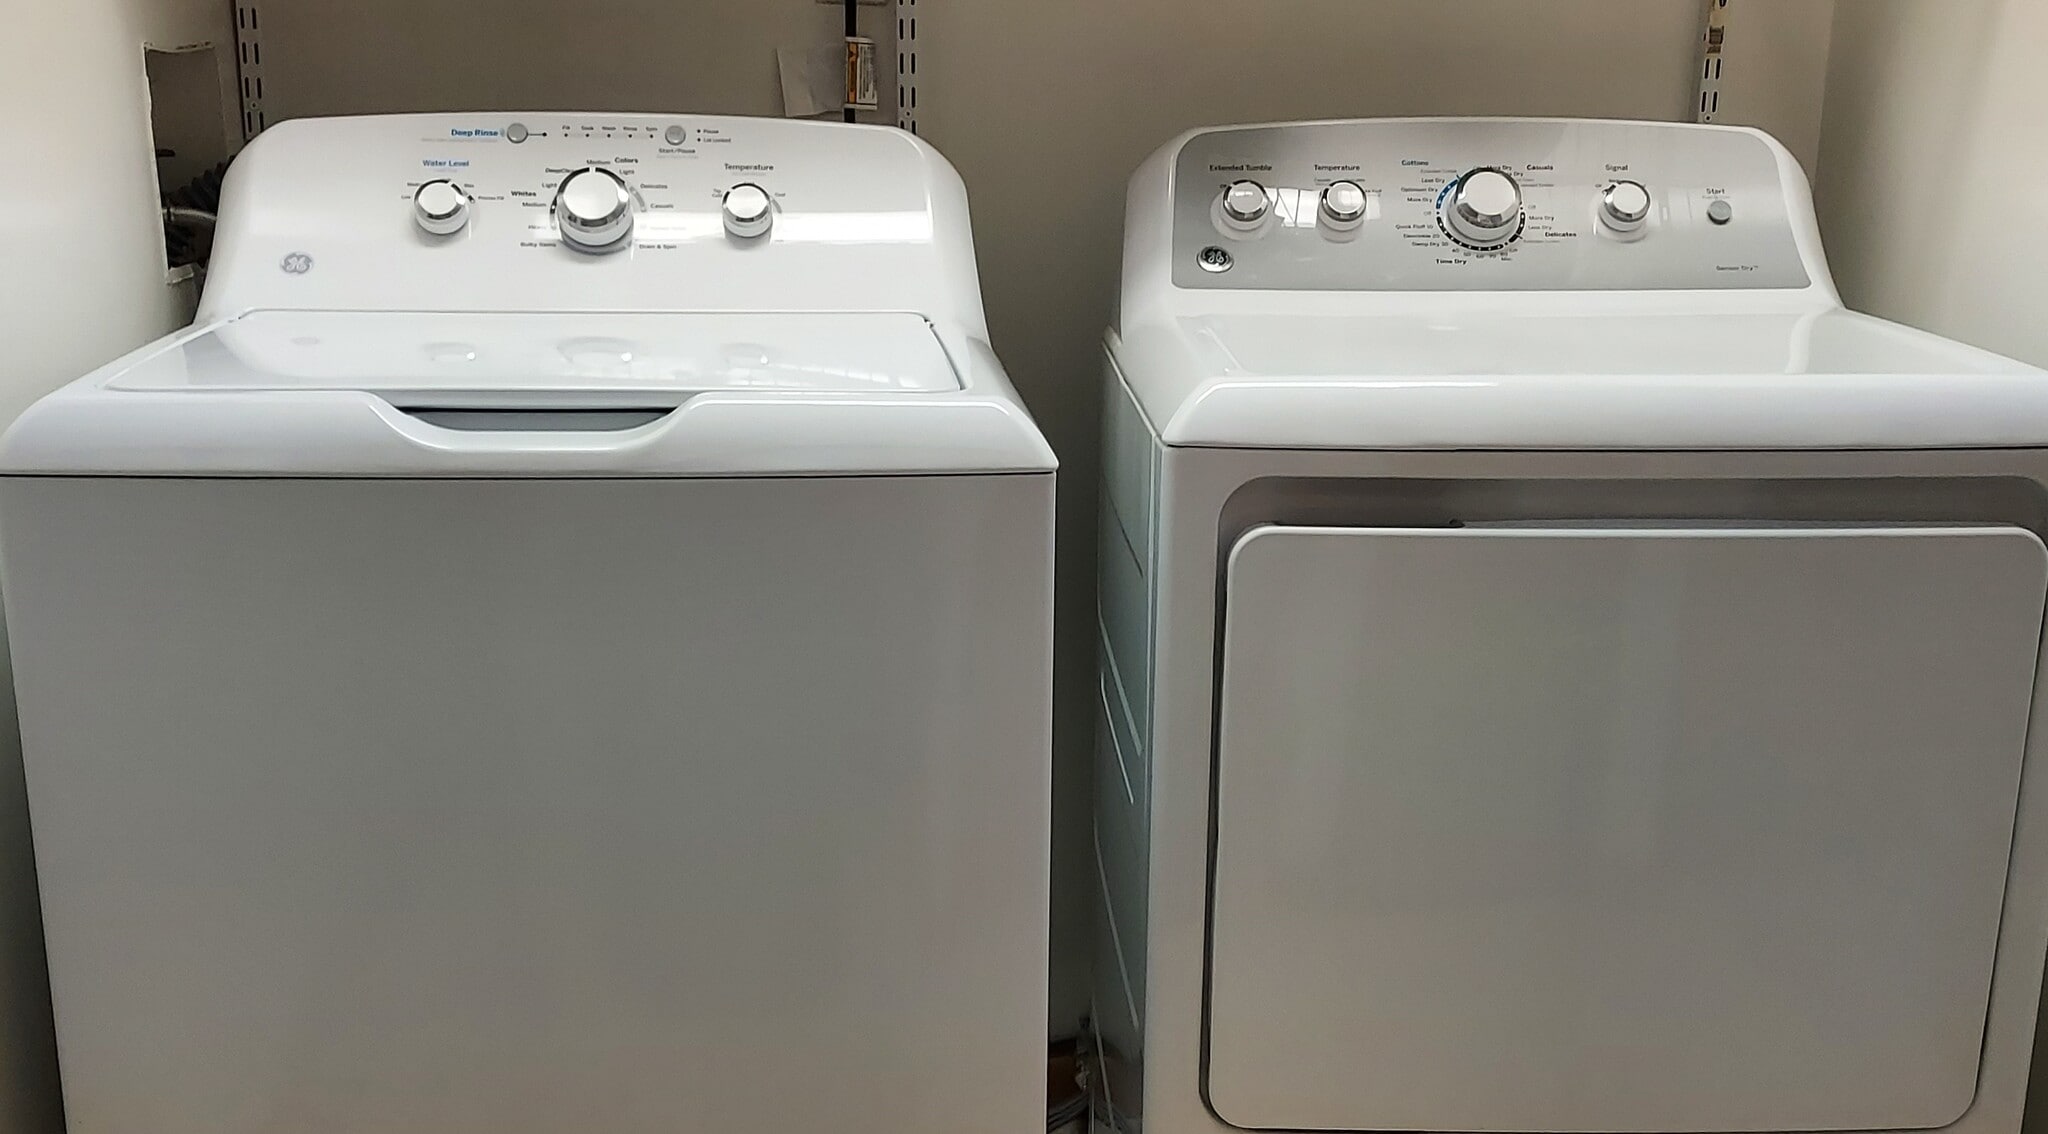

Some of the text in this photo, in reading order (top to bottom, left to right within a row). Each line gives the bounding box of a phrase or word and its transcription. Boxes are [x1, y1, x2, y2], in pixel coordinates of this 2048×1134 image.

[451, 128, 498, 137] Deep Rinse
[614, 156, 639, 164] Colors
[724, 163, 774, 171] Temperature
[1246, 164, 1272, 172] Tumble
